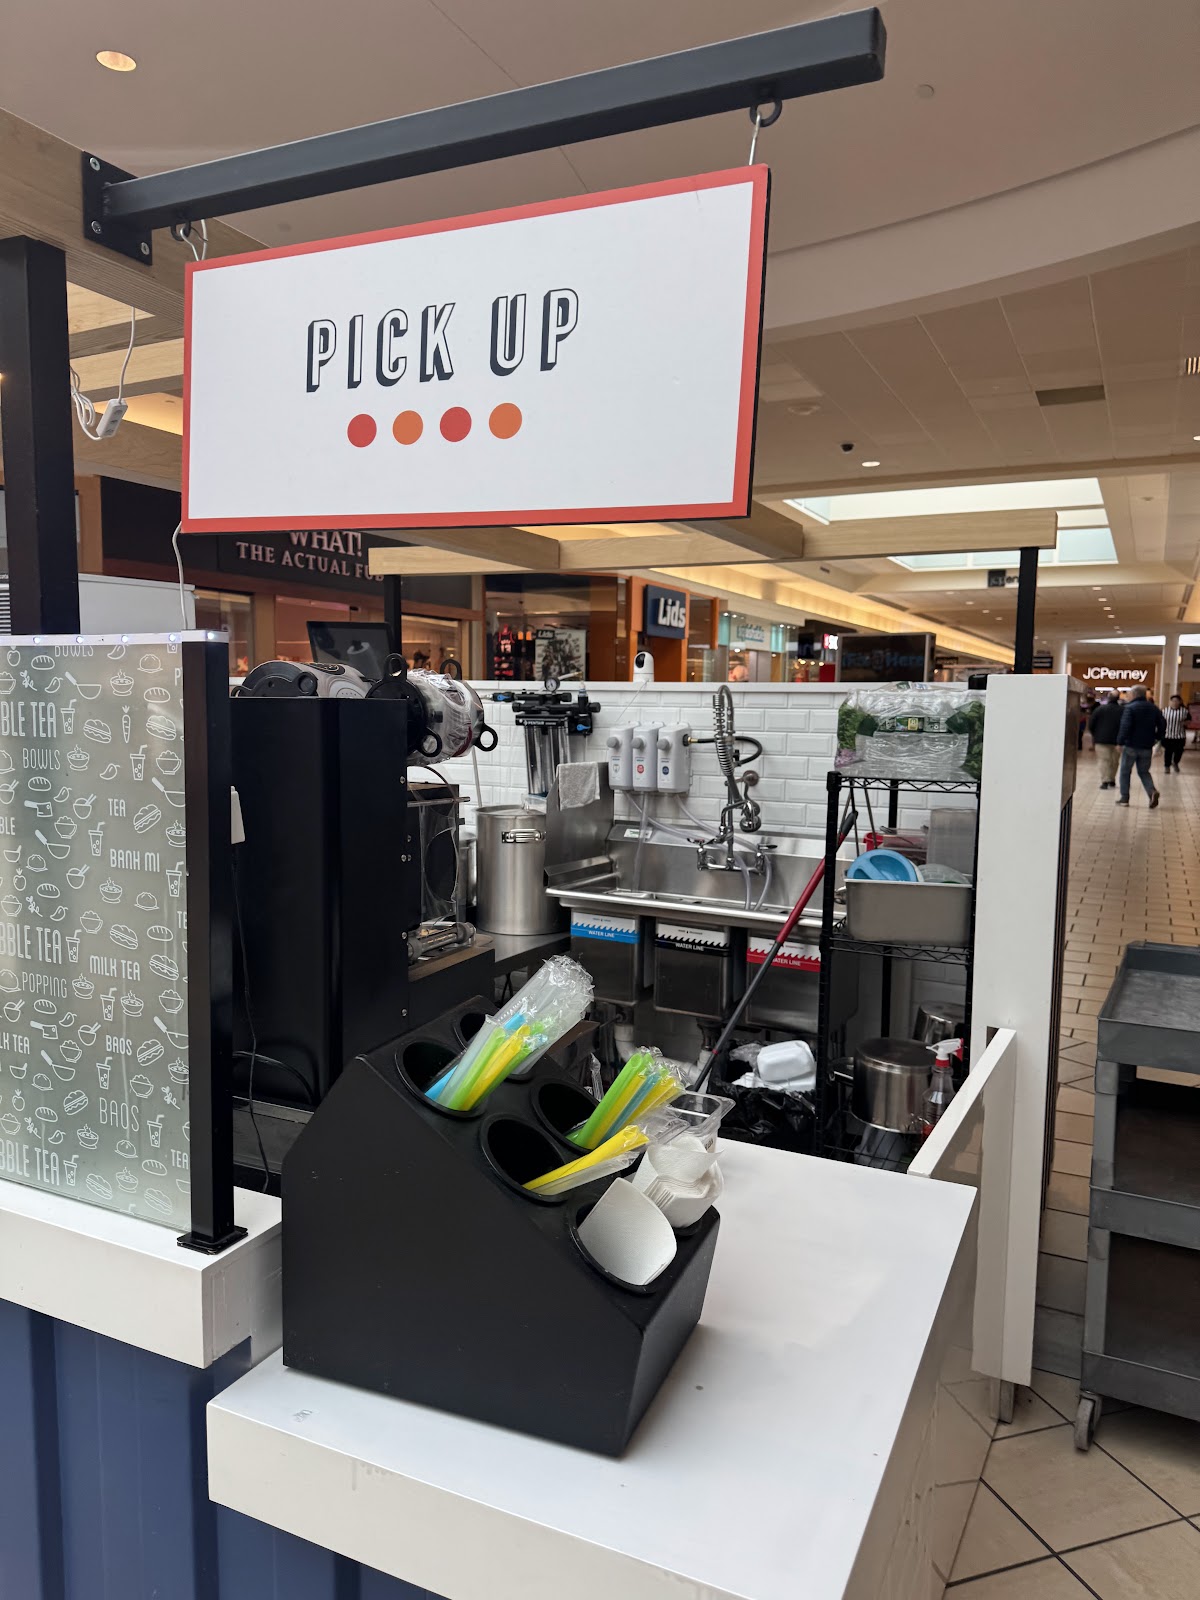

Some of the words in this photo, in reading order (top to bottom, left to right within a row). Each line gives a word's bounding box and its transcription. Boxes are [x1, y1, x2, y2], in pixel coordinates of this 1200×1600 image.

[306, 302, 456, 393] PICK
[490, 287, 580, 377] UP
[289, 531, 362, 557] WHAT!
[236, 541, 275, 563] THE
[281, 550, 350, 576] ACTUAL
[658, 597, 686, 628] Lids
[1083, 666, 1148, 682] JCPenney
[1, 701, 26, 736] BLE
[30, 702, 57, 738] TEA
[22, 748, 61, 770] BOWLS
[108, 798, 126, 817] TEA
[0, 817, 16, 835] BLE
[110, 849, 140, 870] BANH
[144, 852, 160, 872] MI
[177, 911, 187, 930] TE
[0, 922, 32, 959] BBLE
[36, 927, 61, 964] TEA
[89, 955, 117, 978] MILK
[121, 960, 141, 981] TEA
[22, 972, 67, 998] POPPING
[12, 1034, 30, 1055] TEA
[106, 1035, 133, 1056] BAOS
[100, 1098, 139, 1132] BAOS
[0, 1138, 30, 1177] BBLE
[34, 1147, 60, 1185] TEA
[170, 1149, 189, 1170] TEA
